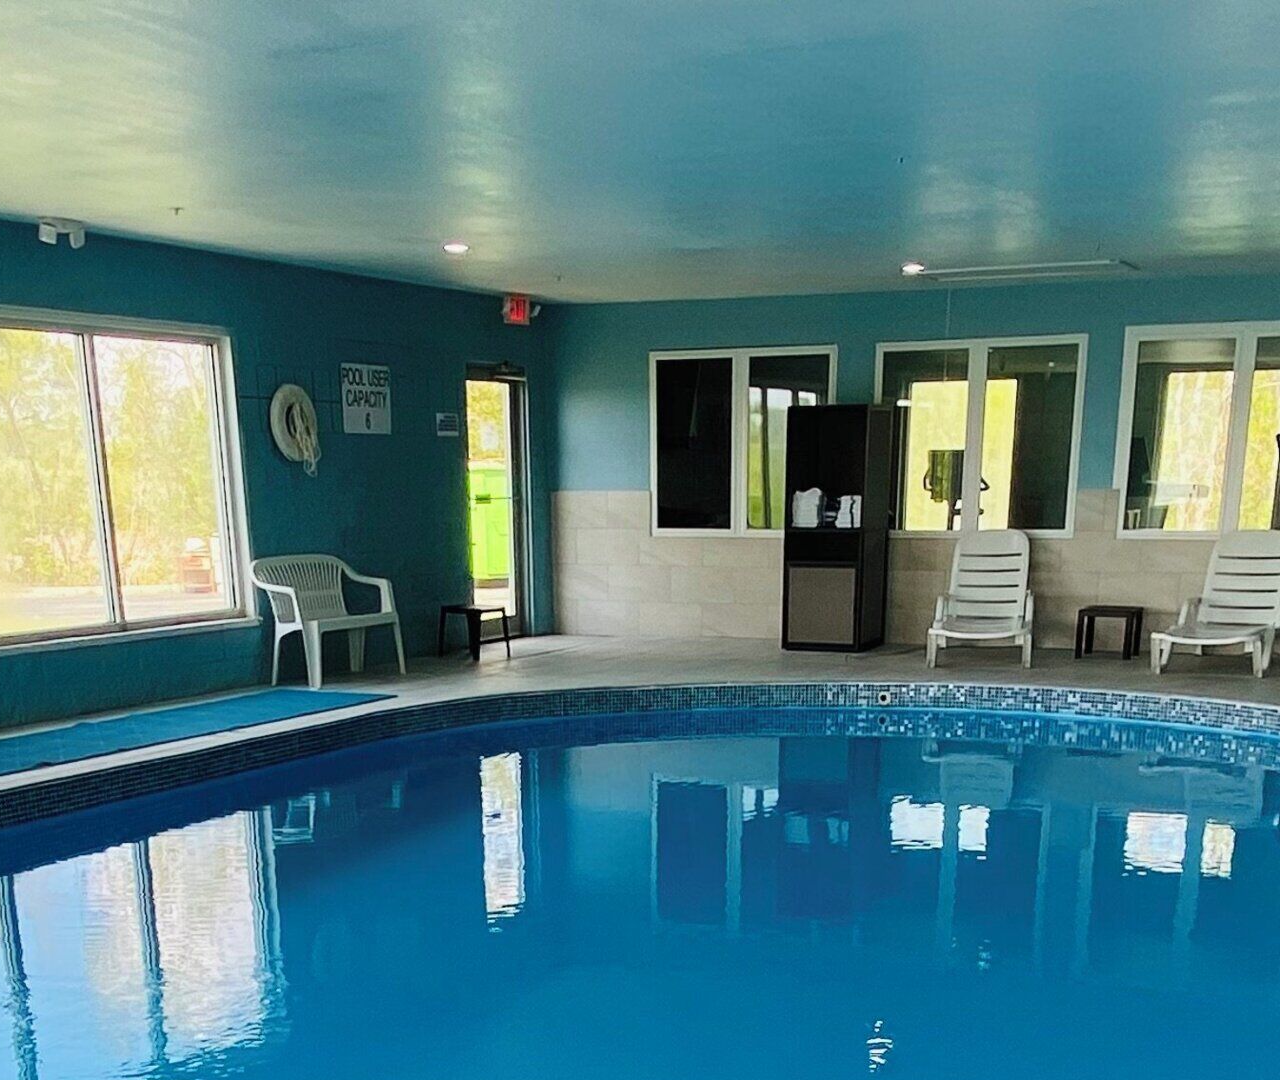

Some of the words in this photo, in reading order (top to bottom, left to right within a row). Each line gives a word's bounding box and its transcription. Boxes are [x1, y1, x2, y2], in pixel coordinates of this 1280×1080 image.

[341, 367, 366, 387] POOL
[367, 369, 389, 388] USER
[345, 389, 388, 409] CAPACITY
[365, 412, 372, 430] 6
